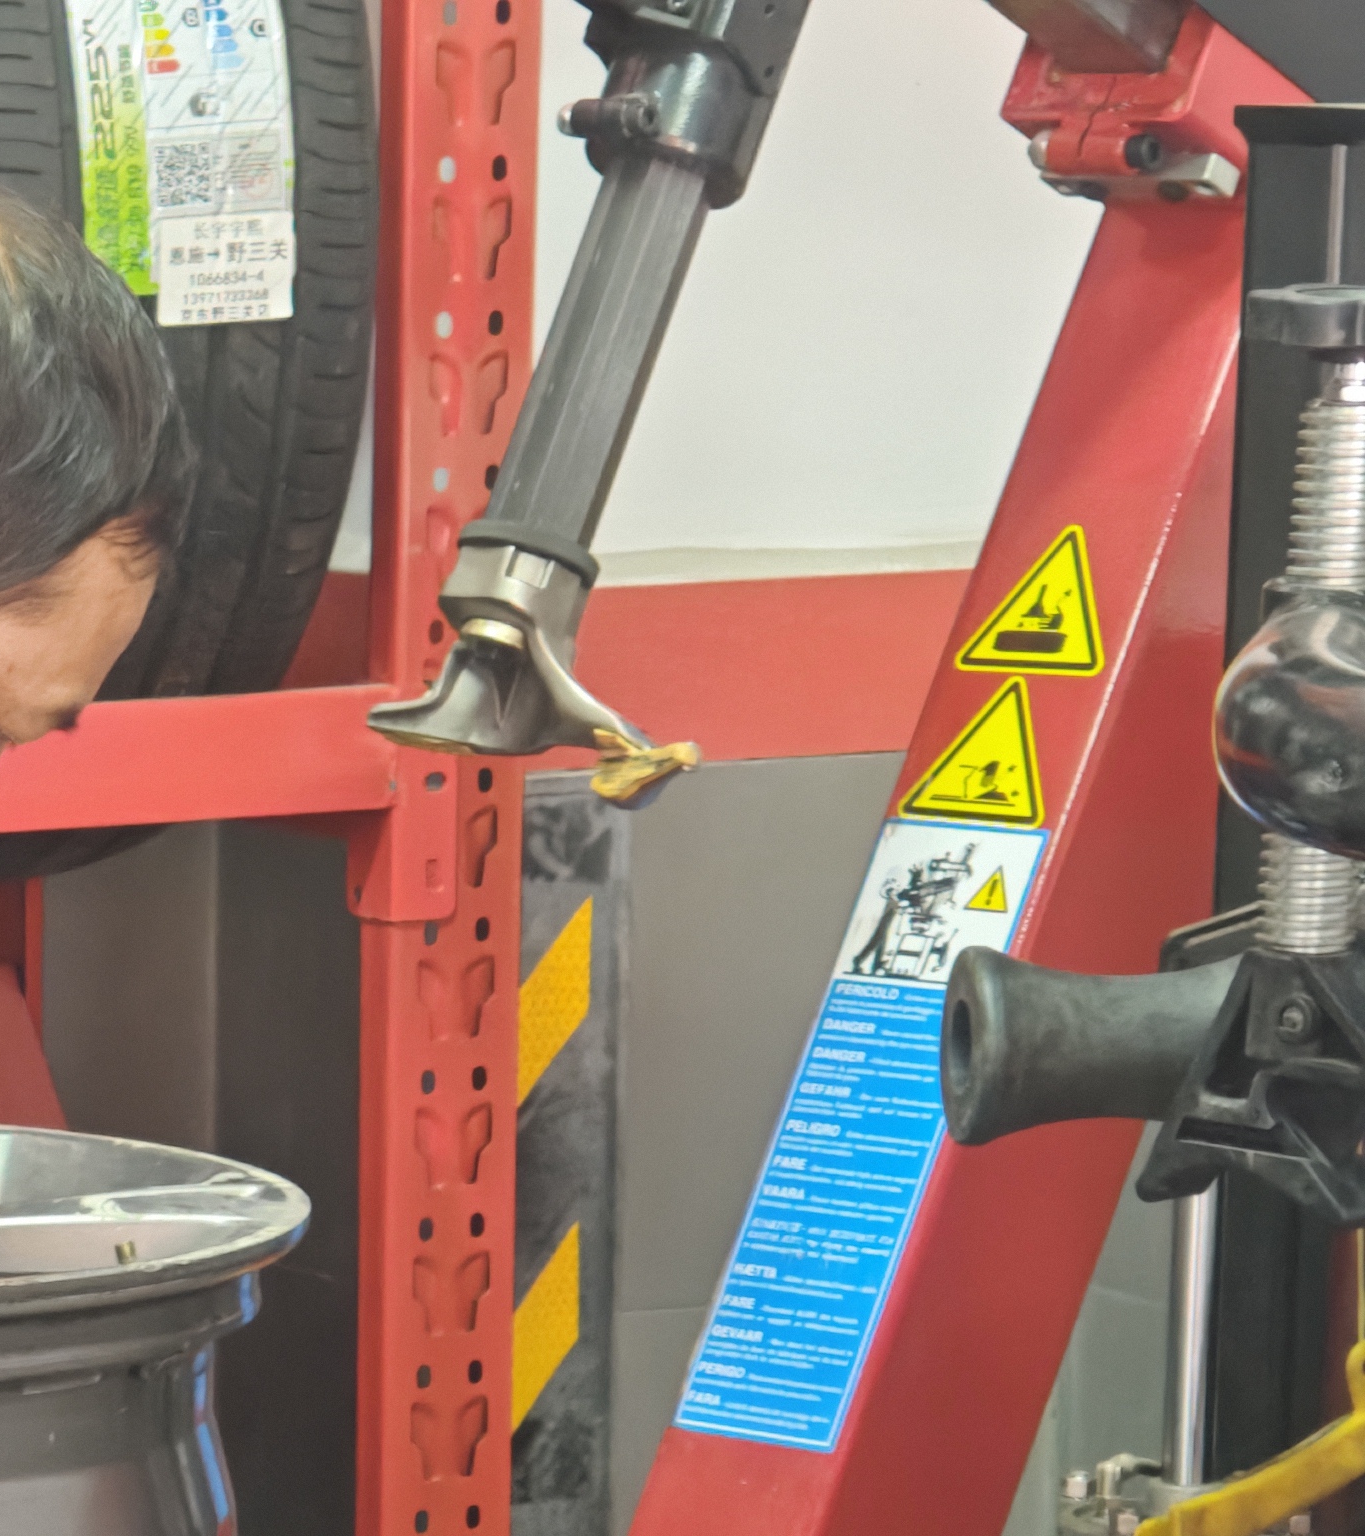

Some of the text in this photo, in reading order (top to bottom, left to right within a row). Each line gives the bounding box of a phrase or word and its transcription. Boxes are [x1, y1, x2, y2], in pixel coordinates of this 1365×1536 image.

[821, 1018, 877, 1034] DANGER
[811, 1046, 867, 1063] DANGER
[785, 1118, 842, 1138] PELIGRO
